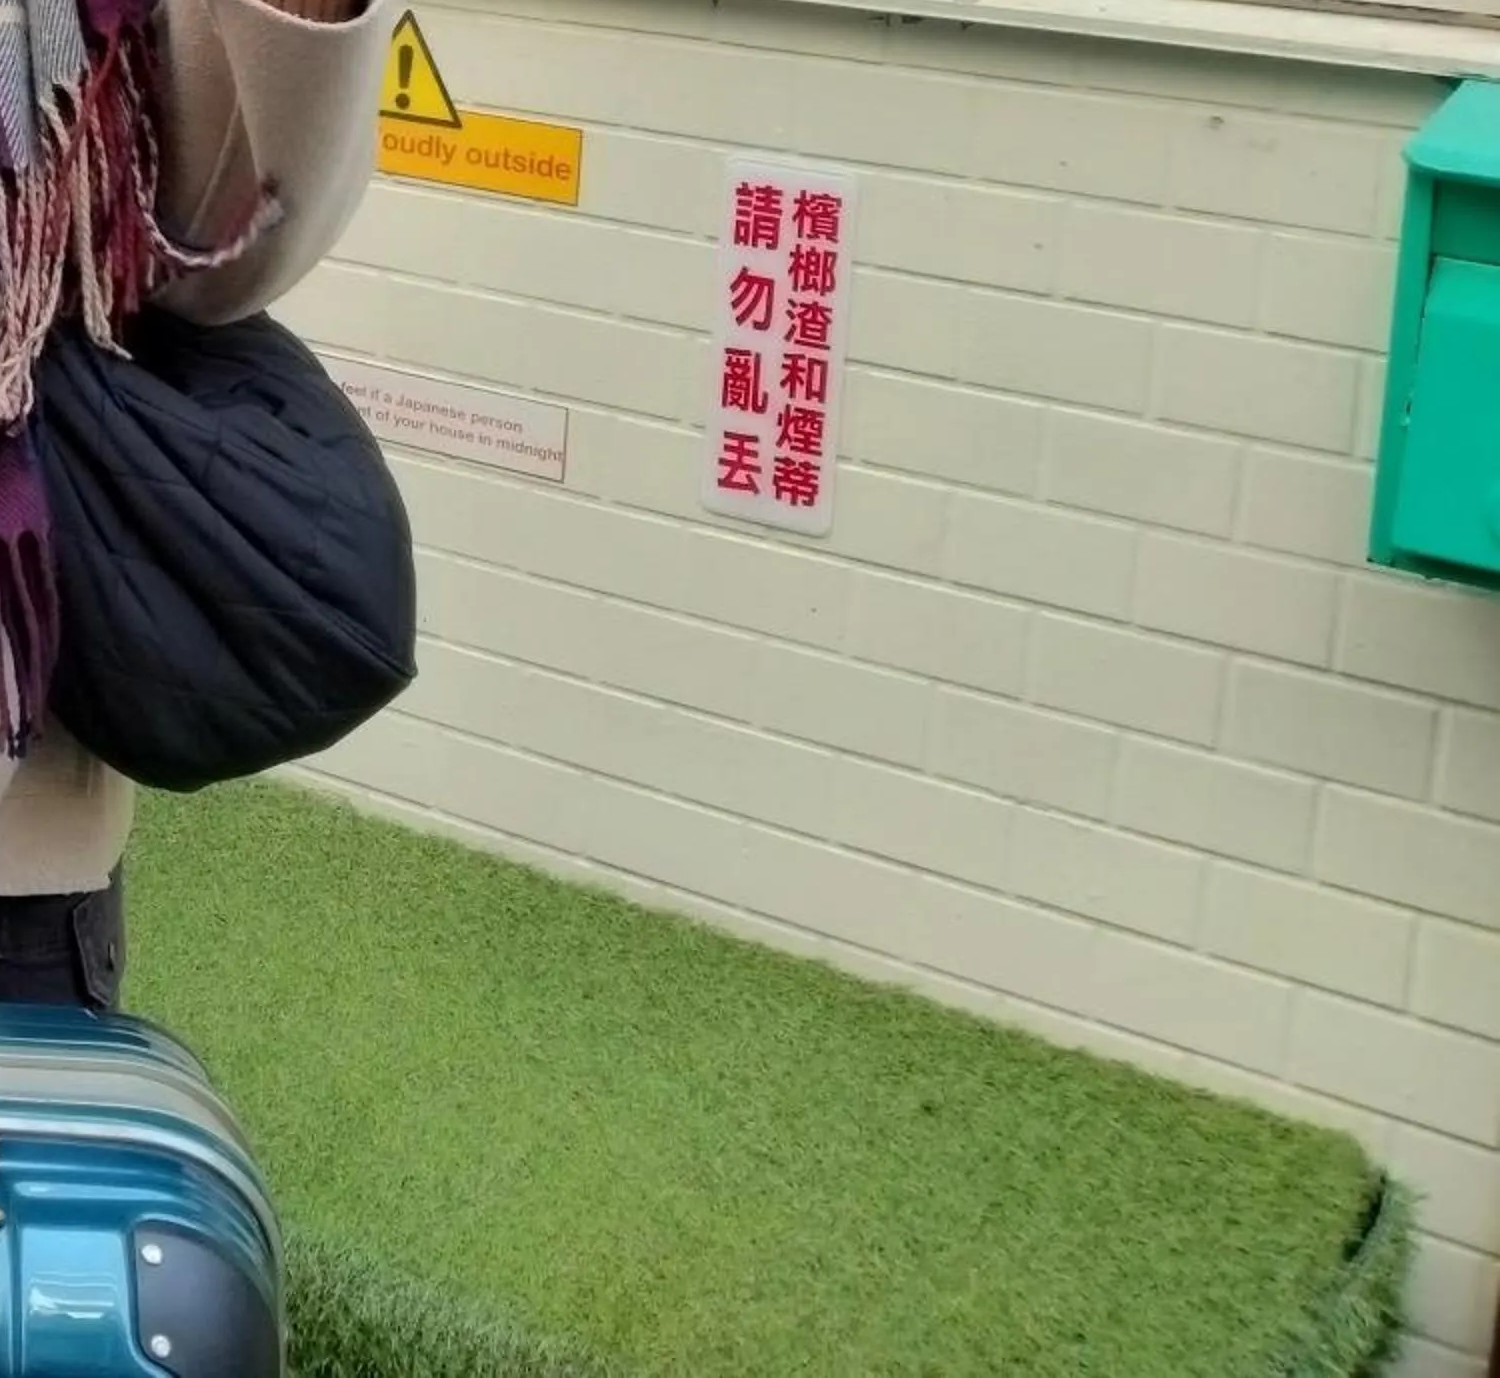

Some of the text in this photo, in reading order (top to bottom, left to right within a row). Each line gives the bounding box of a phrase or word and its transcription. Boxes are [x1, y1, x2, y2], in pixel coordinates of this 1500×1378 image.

[381, 131, 573, 181] oudly outside
[772, 190, 842, 508] 檳榔渣和煙蒂
[375, 410, 391, 422] of
[393, 415, 425, 431] your
[429, 422, 475, 443] house
[479, 433, 492, 446] in
[496, 438, 565, 462] midnight
[383, 392, 392, 403] a
[396, 393, 467, 420] Japanese
[471, 413, 523, 433] person
